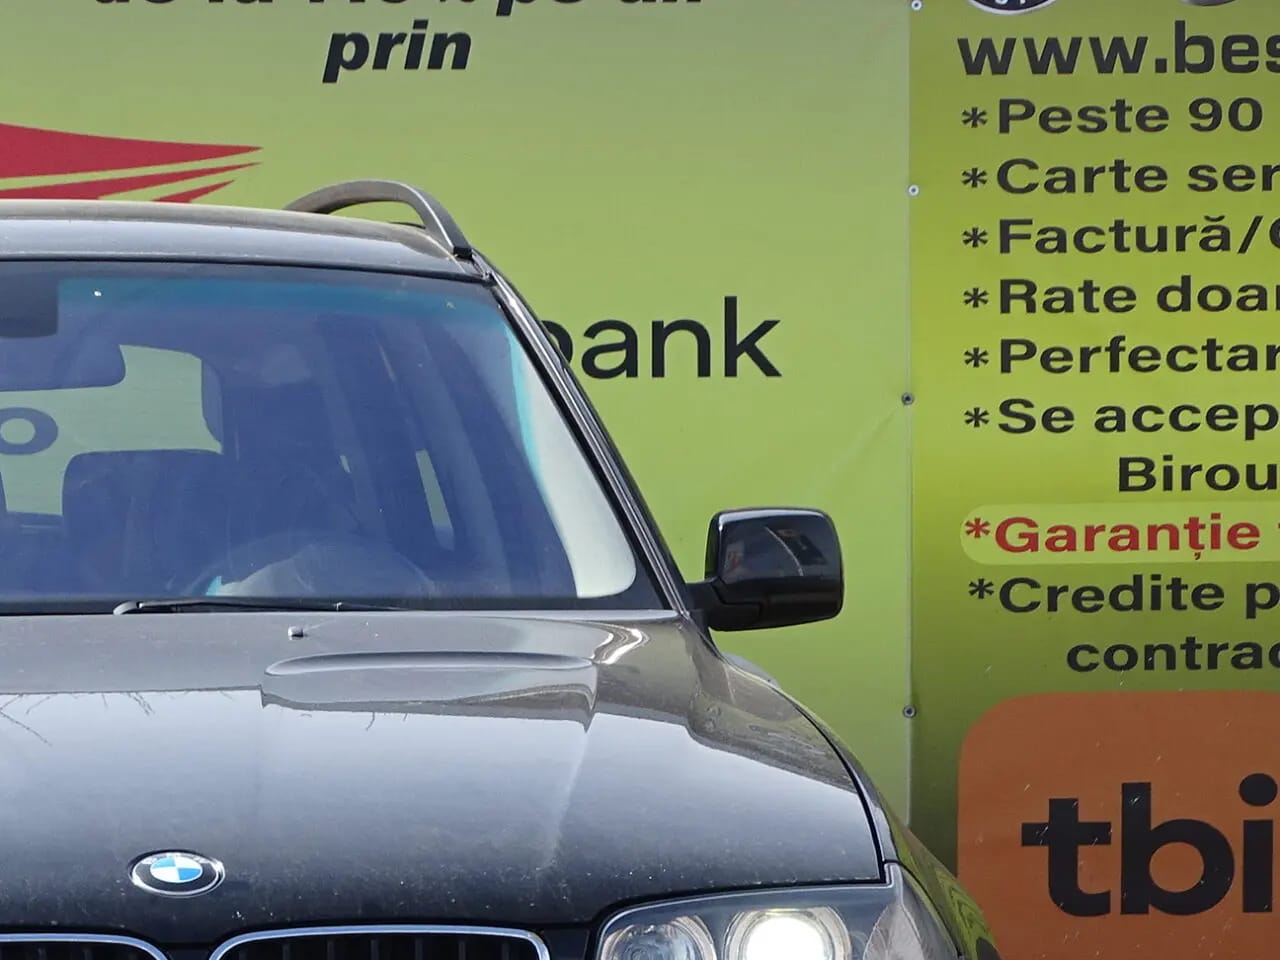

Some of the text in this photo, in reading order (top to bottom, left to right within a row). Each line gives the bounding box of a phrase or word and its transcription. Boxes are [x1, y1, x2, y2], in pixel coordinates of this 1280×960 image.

[322, 19, 472, 84] prin
[1188, 97, 1264, 133] 90
[962, 215, 1280, 254] Factură/
[1157, 274, 1280, 313] doa
[1093, 402, 1280, 441] accep
[1119, 454, 1278, 492] Birou
[1021, 773, 1278, 917] tbi
